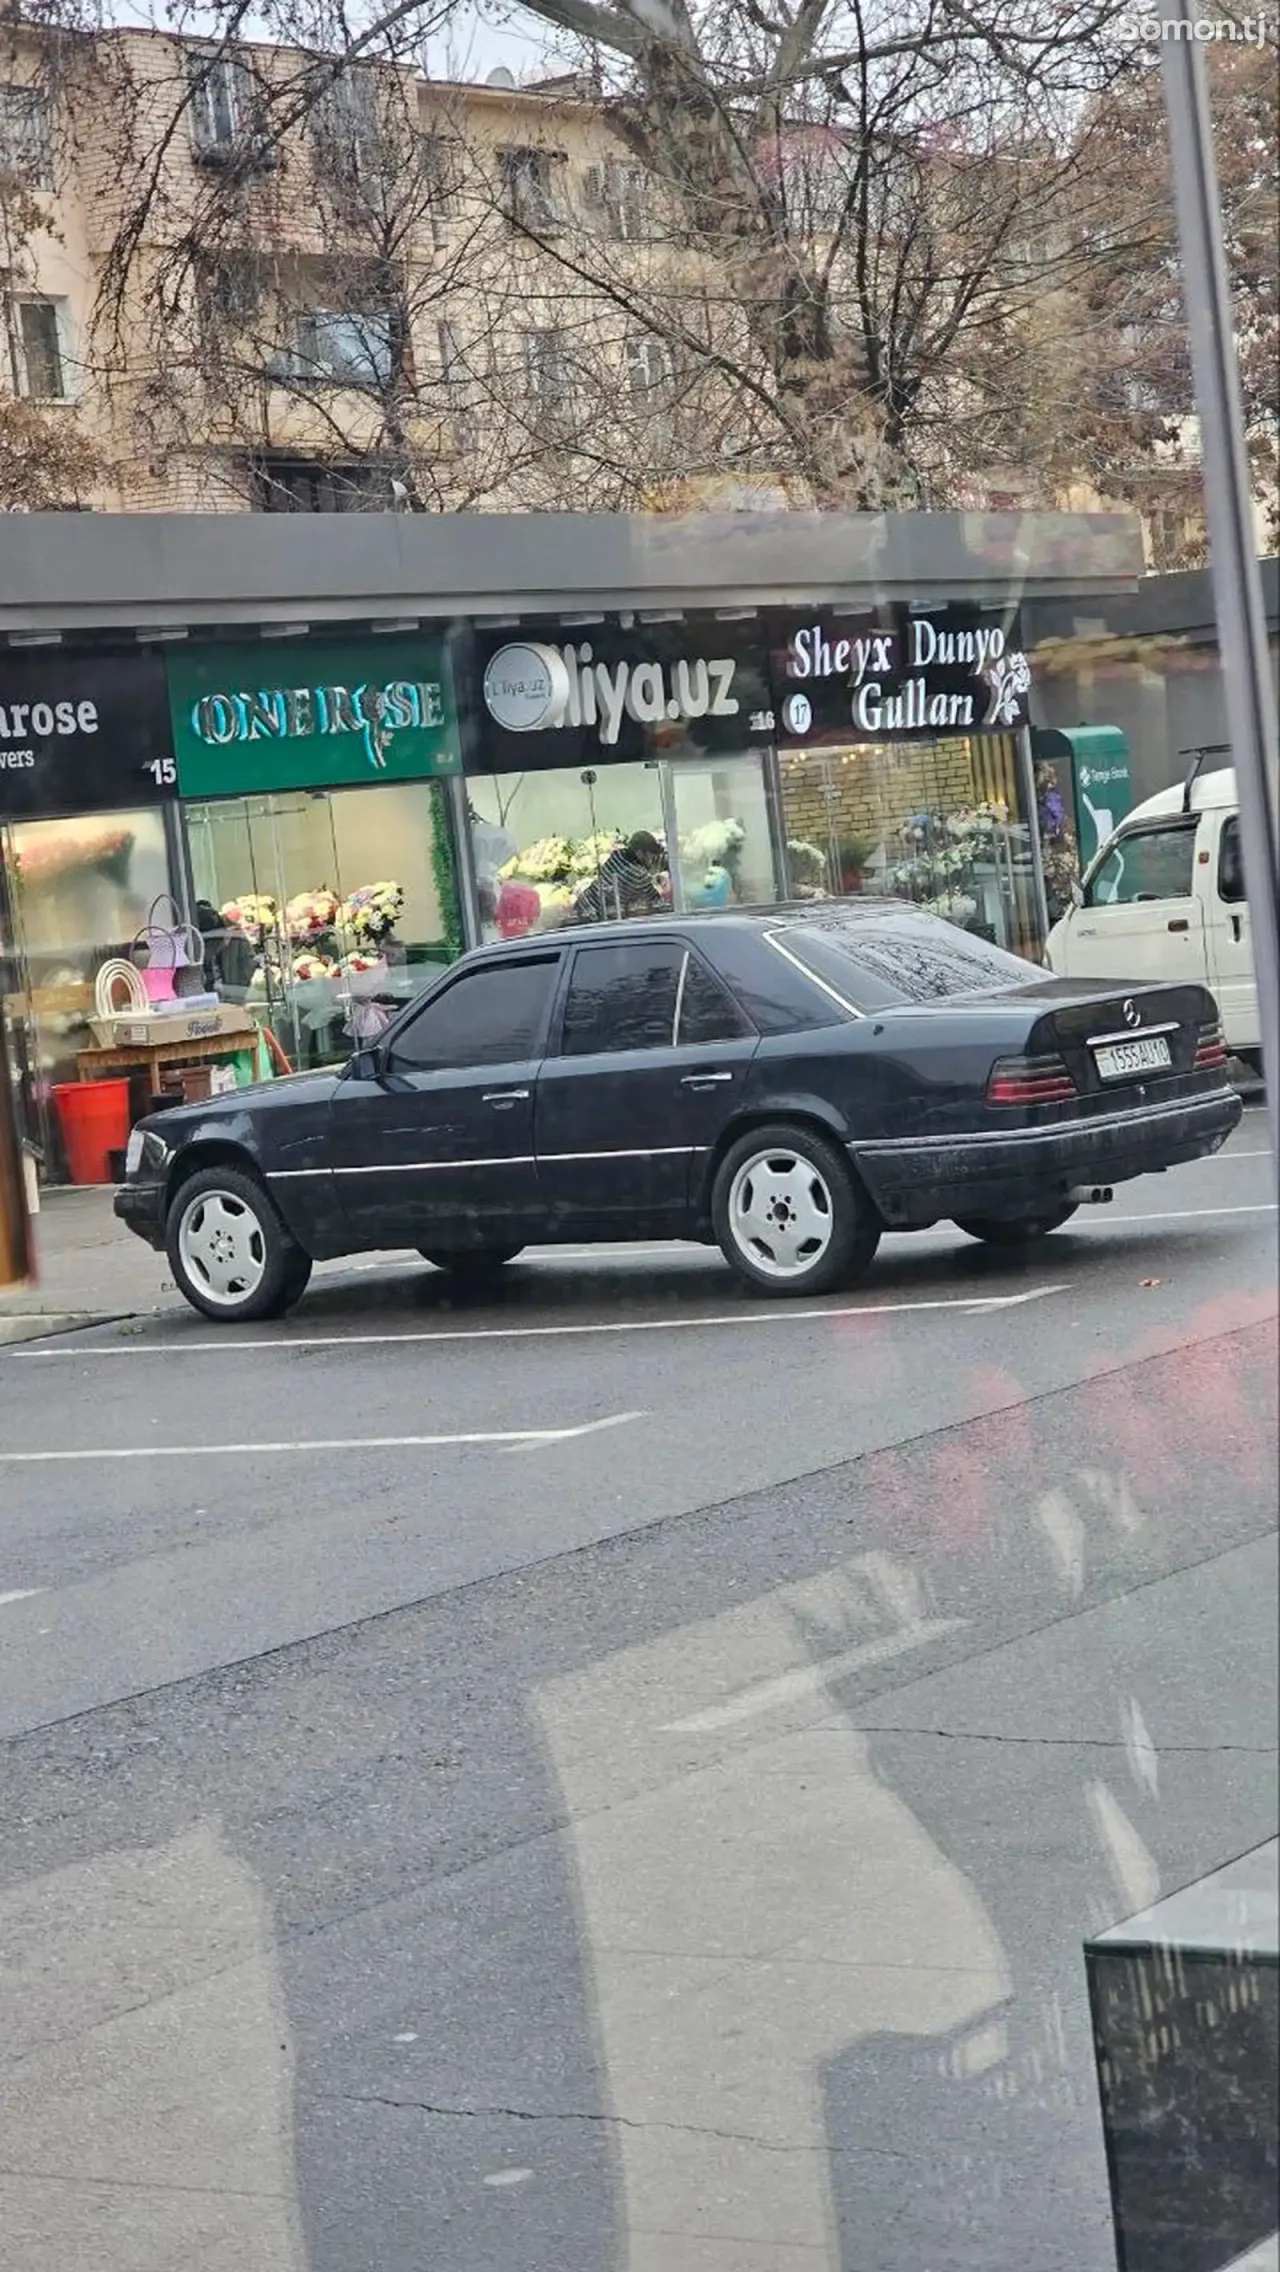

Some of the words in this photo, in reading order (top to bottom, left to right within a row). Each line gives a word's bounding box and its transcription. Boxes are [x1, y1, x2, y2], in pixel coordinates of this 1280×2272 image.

[793, 625, 893, 687] Sheyx
[911, 619, 1005, 676] Dunyo
[551, 641, 740, 744] liya.uz
[794, 703, 808, 725] 17
[150, 757, 176, 785] 15
